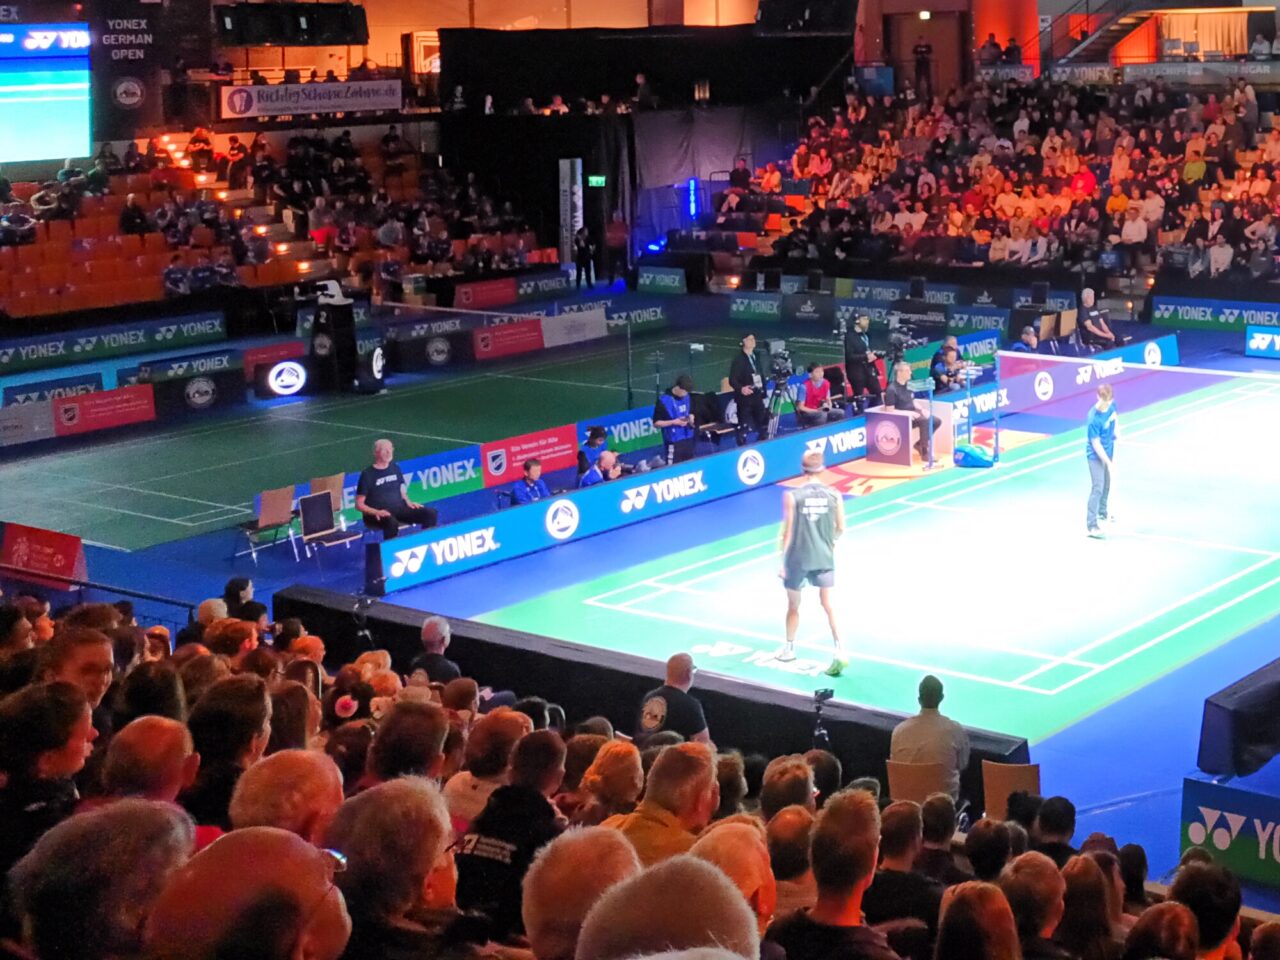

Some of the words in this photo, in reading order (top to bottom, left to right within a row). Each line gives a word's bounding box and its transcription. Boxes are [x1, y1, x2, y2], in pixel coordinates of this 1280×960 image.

[107, 19, 148, 30] YONEX
[102, 33, 153, 45] GERMAN
[111, 49, 144, 60] OPEN
[1074, 67, 1112, 81] YONEX
[536, 276, 569, 292] YONEX
[655, 273, 681, 287] YONEX
[871, 287, 901, 301] YONEX
[925, 291, 956, 304] YONEX
[629, 306, 664, 323] YONEX
[750, 300, 779, 314] YONEX
[319, 311, 327, 324] 2
[970, 315, 1005, 331] YONEX
[1176, 306, 1212, 321] YONEX
[1242, 309, 1279, 325] YONEX
[430, 319, 461, 334] YONEX
[20, 341, 66, 360] YONEX
[101, 329, 146, 347] YONEX
[180, 319, 222, 336] YONEX
[966, 337, 997, 358] YONEX
[192, 355, 229, 372] YONEX
[610, 416, 659, 443] YONEX
[417, 458, 478, 490] YONEX
[649, 471, 705, 503] YONEX
[431, 526, 499, 565] YONEX
